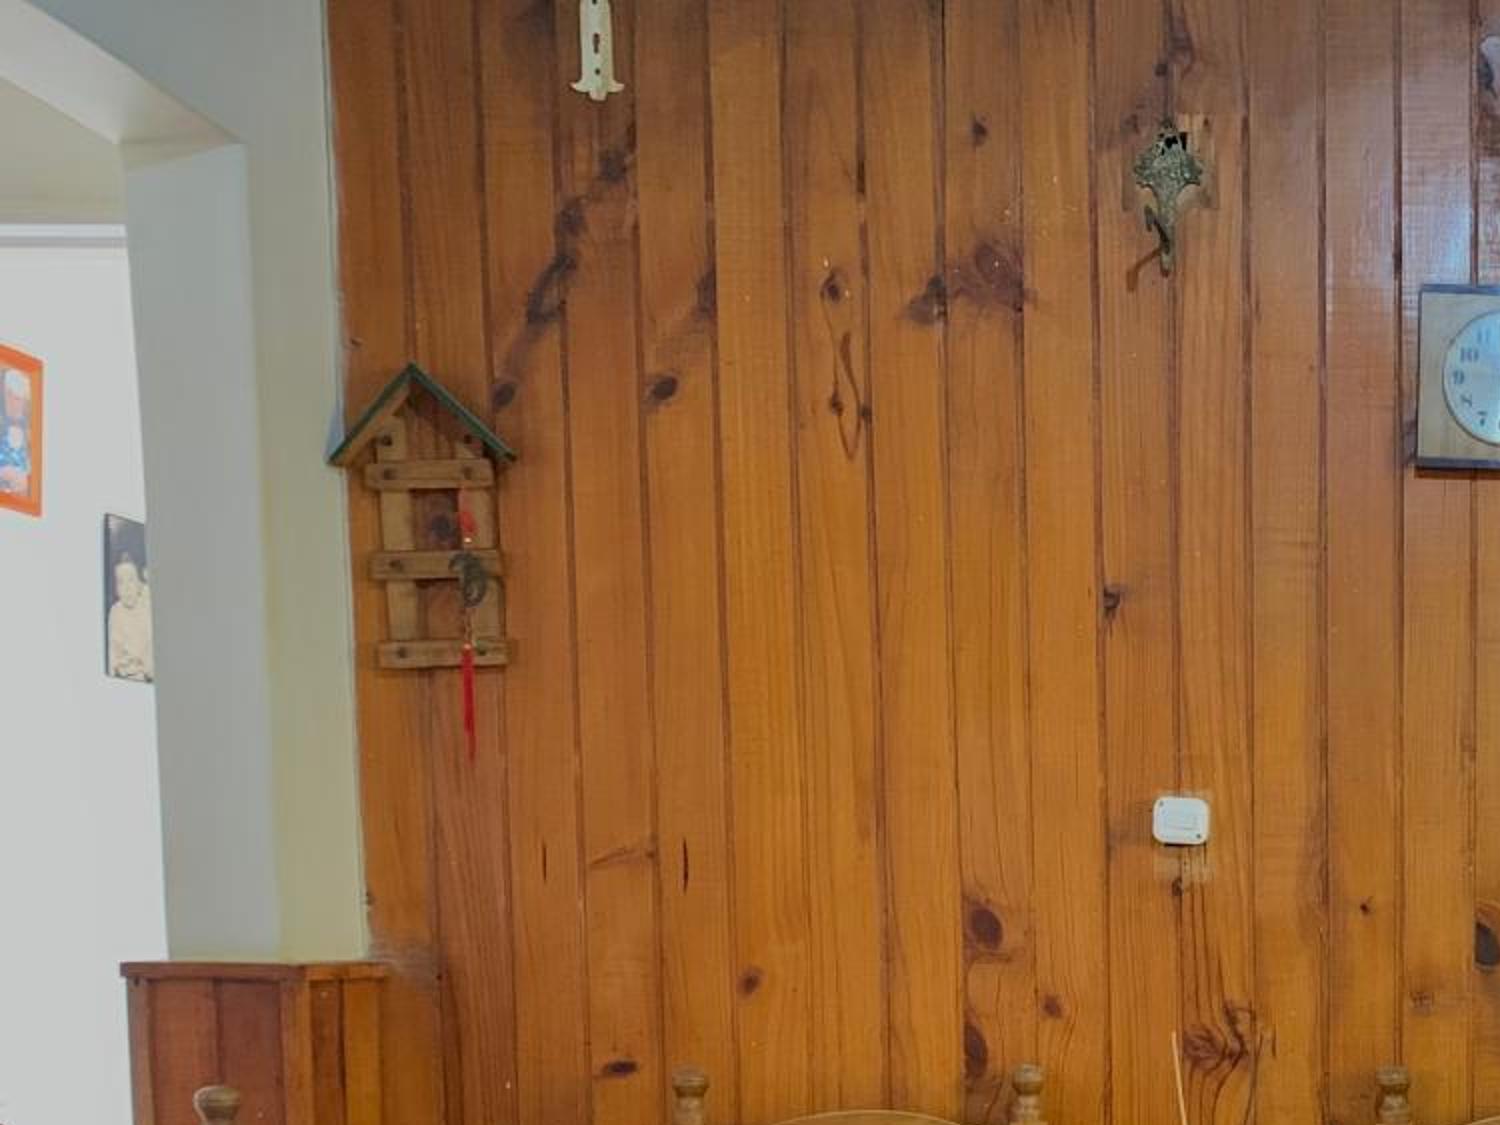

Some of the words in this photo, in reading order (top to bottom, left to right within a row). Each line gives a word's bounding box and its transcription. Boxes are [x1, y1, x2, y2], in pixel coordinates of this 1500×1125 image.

[1460, 347, 1479, 363] 10
[1453, 369, 1465, 385] 9
[1476, 410, 1488, 427] 7
